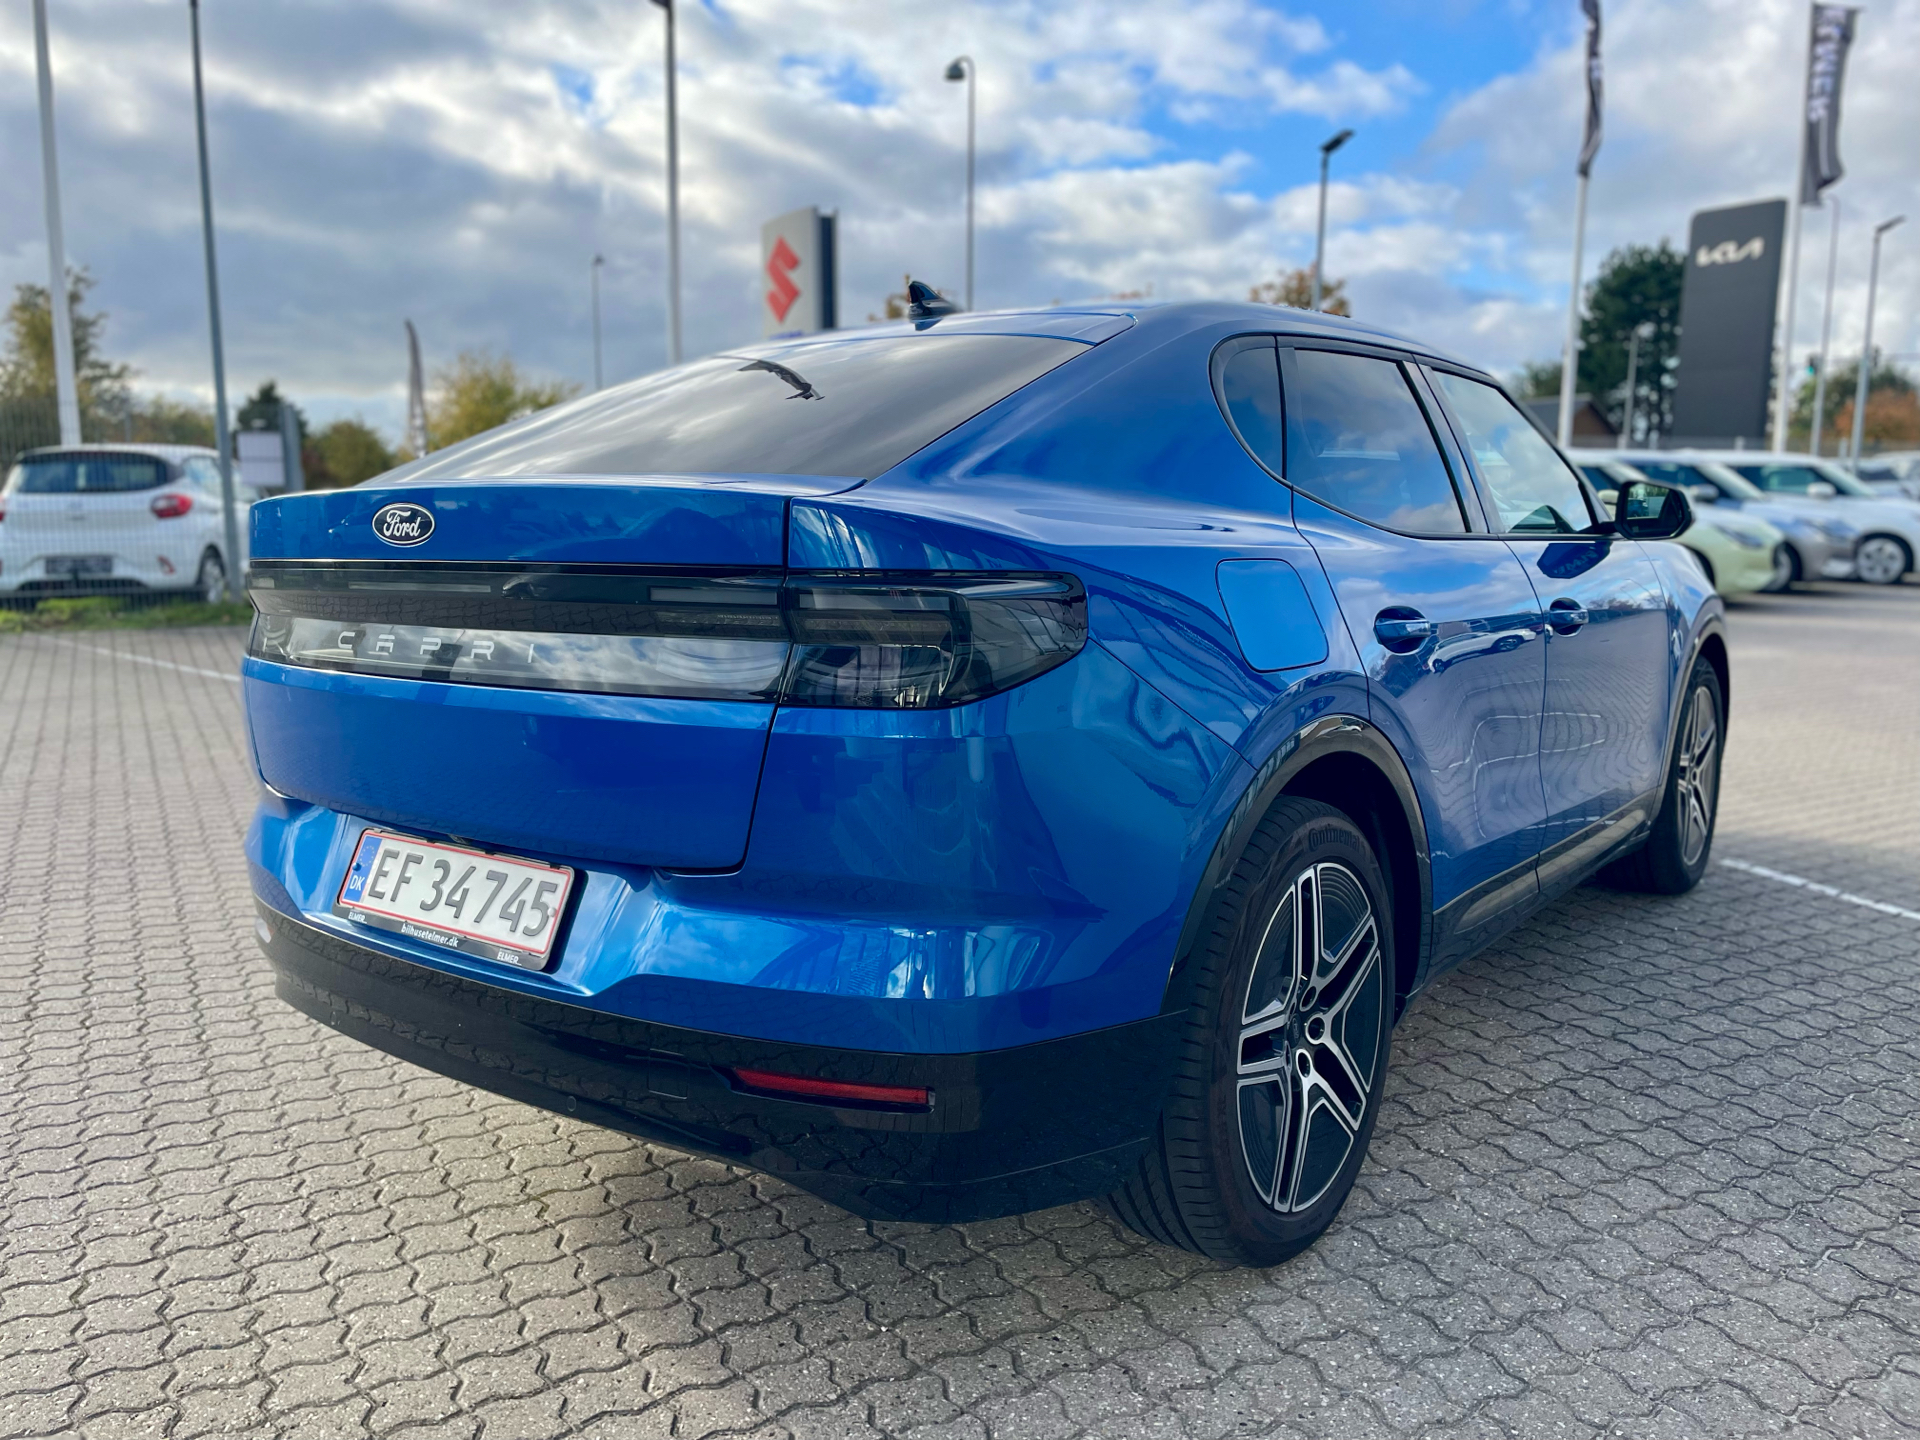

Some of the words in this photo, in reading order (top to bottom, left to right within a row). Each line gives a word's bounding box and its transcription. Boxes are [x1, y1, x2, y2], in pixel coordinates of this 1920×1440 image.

[383, 509, 421, 537] Ford
[338, 631, 535, 664] CAPRI
[1308, 826, 1360, 853] Continental
[350, 875, 364, 891] DK
[367, 847, 424, 903] EF
[419, 859, 476, 919] 34
[473, 869, 558, 937] 745
[401, 923, 459, 948] bilhusetelmer.dk
